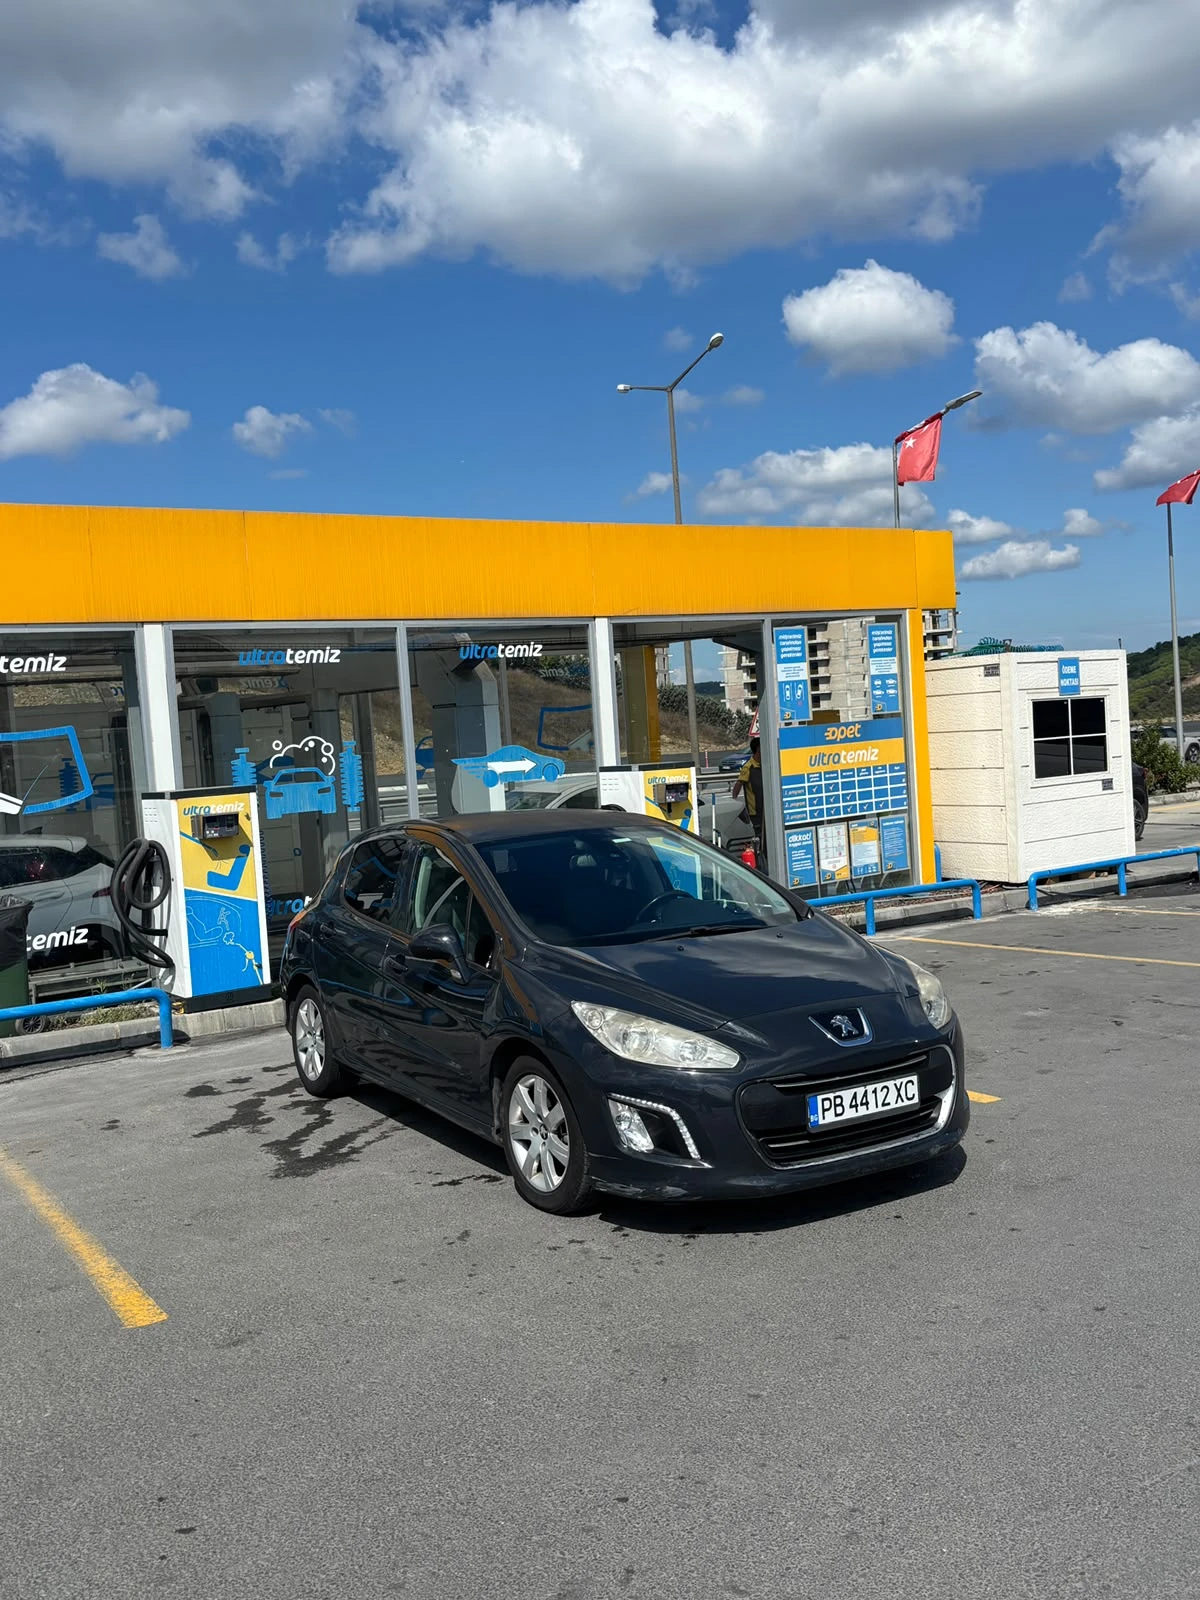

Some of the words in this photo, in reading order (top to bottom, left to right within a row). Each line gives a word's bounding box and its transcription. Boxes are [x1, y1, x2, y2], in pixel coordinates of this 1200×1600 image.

[238, 646, 341, 666] ultratemiz
[458, 641, 543, 660] ultratemiz
[0, 652, 68, 674] temiz
[824, 723, 861, 741] opet
[808, 745, 880, 768] ultratemiz
[182, 800, 245, 816] ultratemiz
[821, 1094, 845, 1120] PB
[849, 1085, 891, 1113] 4412
[894, 1079, 916, 1105] XC
